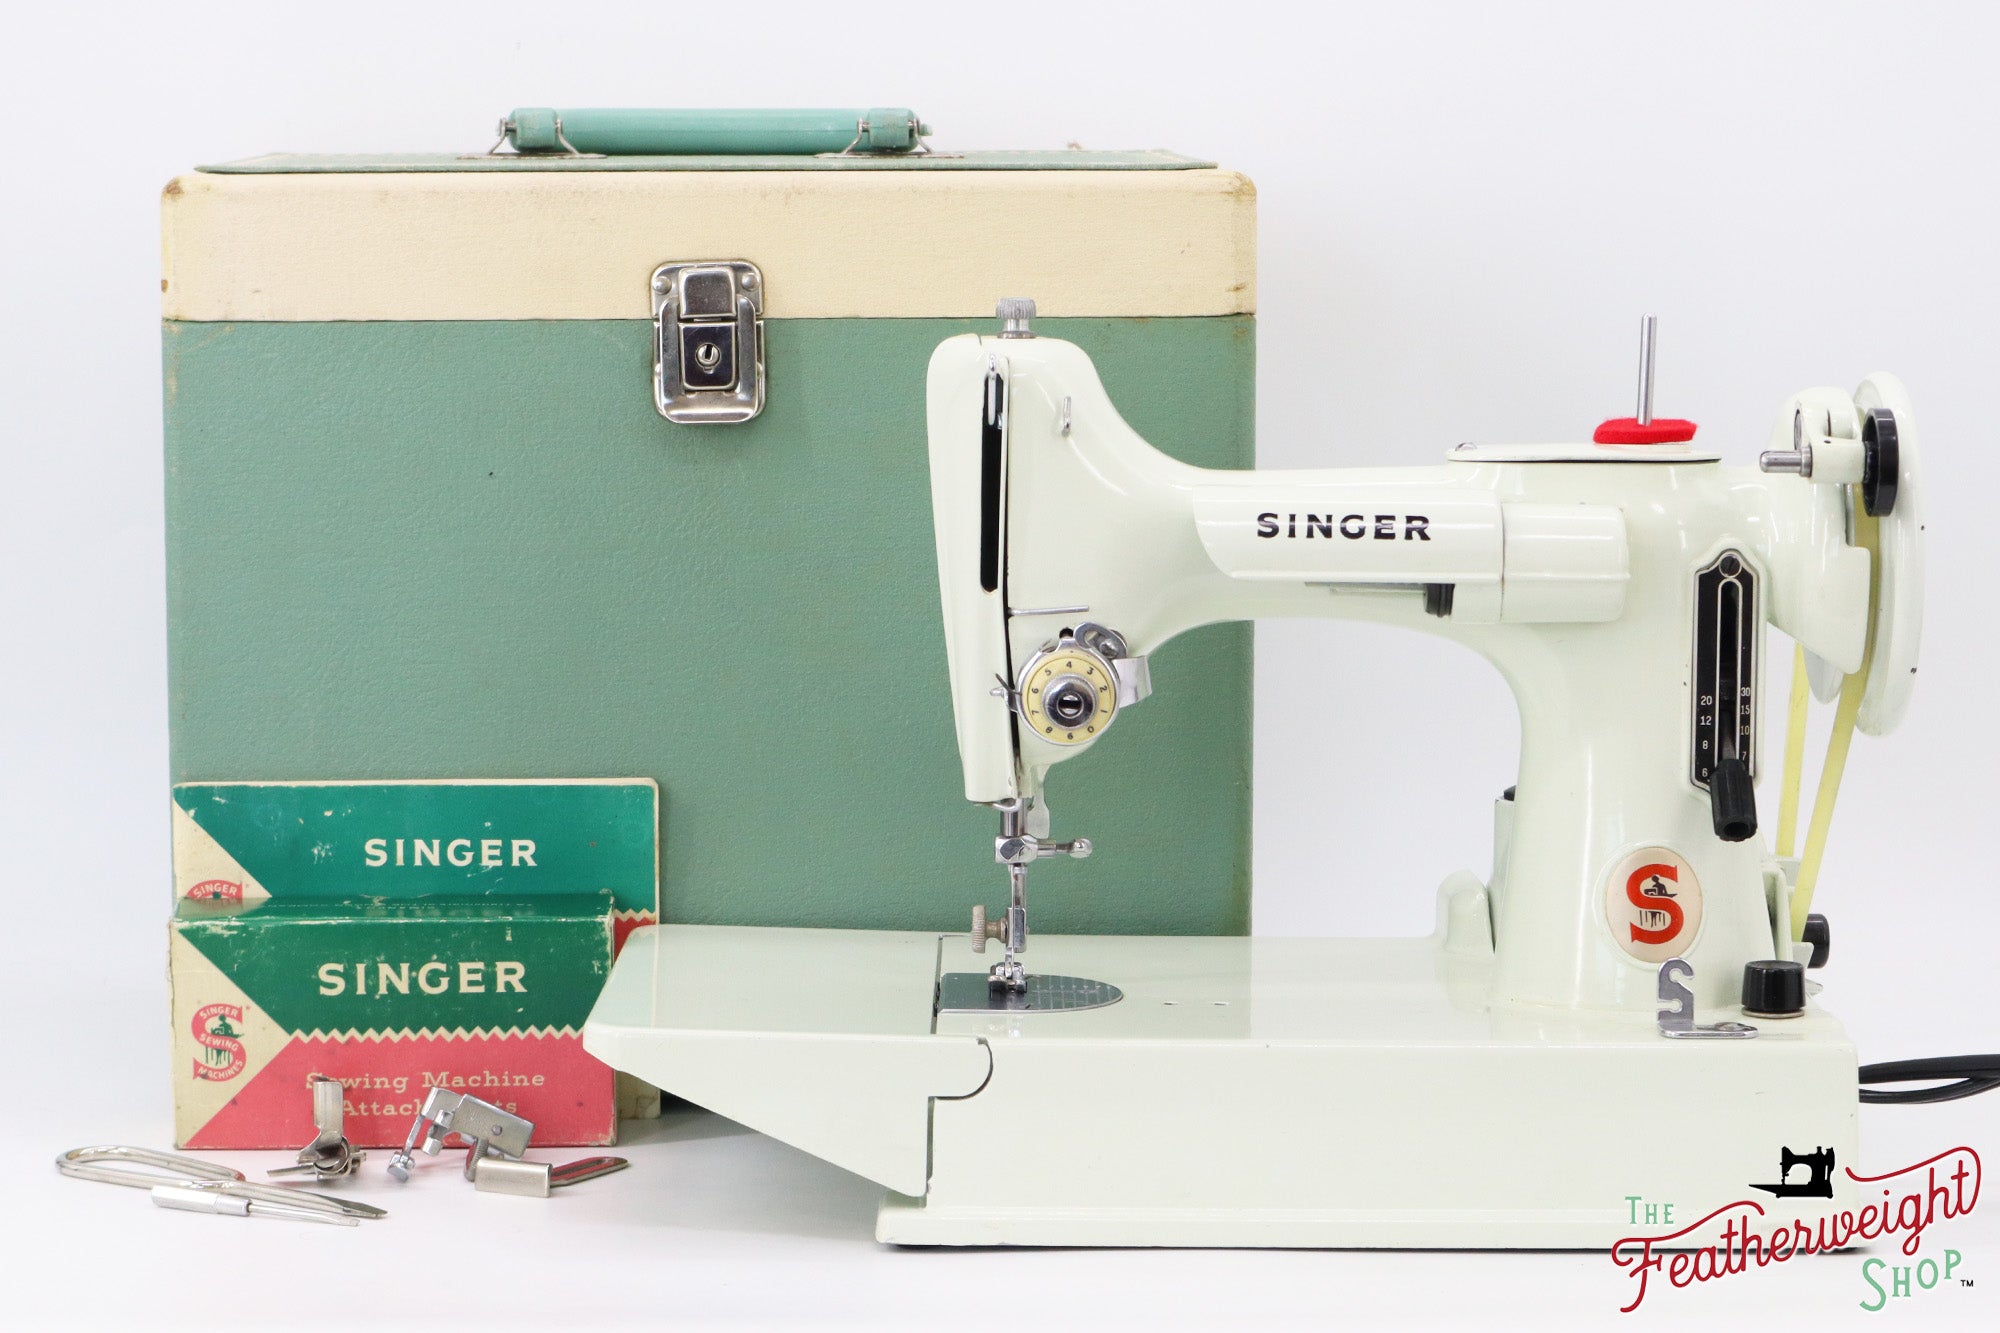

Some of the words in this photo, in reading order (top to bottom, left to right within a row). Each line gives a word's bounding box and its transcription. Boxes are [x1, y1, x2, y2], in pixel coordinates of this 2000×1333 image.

[1257, 512, 1431, 541] SINGER
[1066, 661, 1072, 669] 4
[1045, 668, 1052, 676] 5
[1087, 667, 1094, 675] 3
[1100, 685, 1108, 693] 2
[1740, 687, 1750, 697] 30
[1700, 695, 1713, 706] 20
[1740, 705, 1750, 715] 15
[1700, 715, 1712, 726] 12
[1740, 725, 1750, 736] 10
[1702, 740, 1709, 750] 8
[1742, 751, 1747, 761] 7
[1702, 768, 1708, 777] 6
[364, 838, 538, 867] SINGER
[193, 882, 238, 898] SINGER
[319, 961, 528, 996] SINGER
[199, 1006, 239, 1020] SINGER
[199, 1032, 240, 1052] SEWING
[197, 1059, 244, 1080] MACHINES
[306, 1072, 408, 1094] Swing
[422, 1071, 545, 1088] Machine
